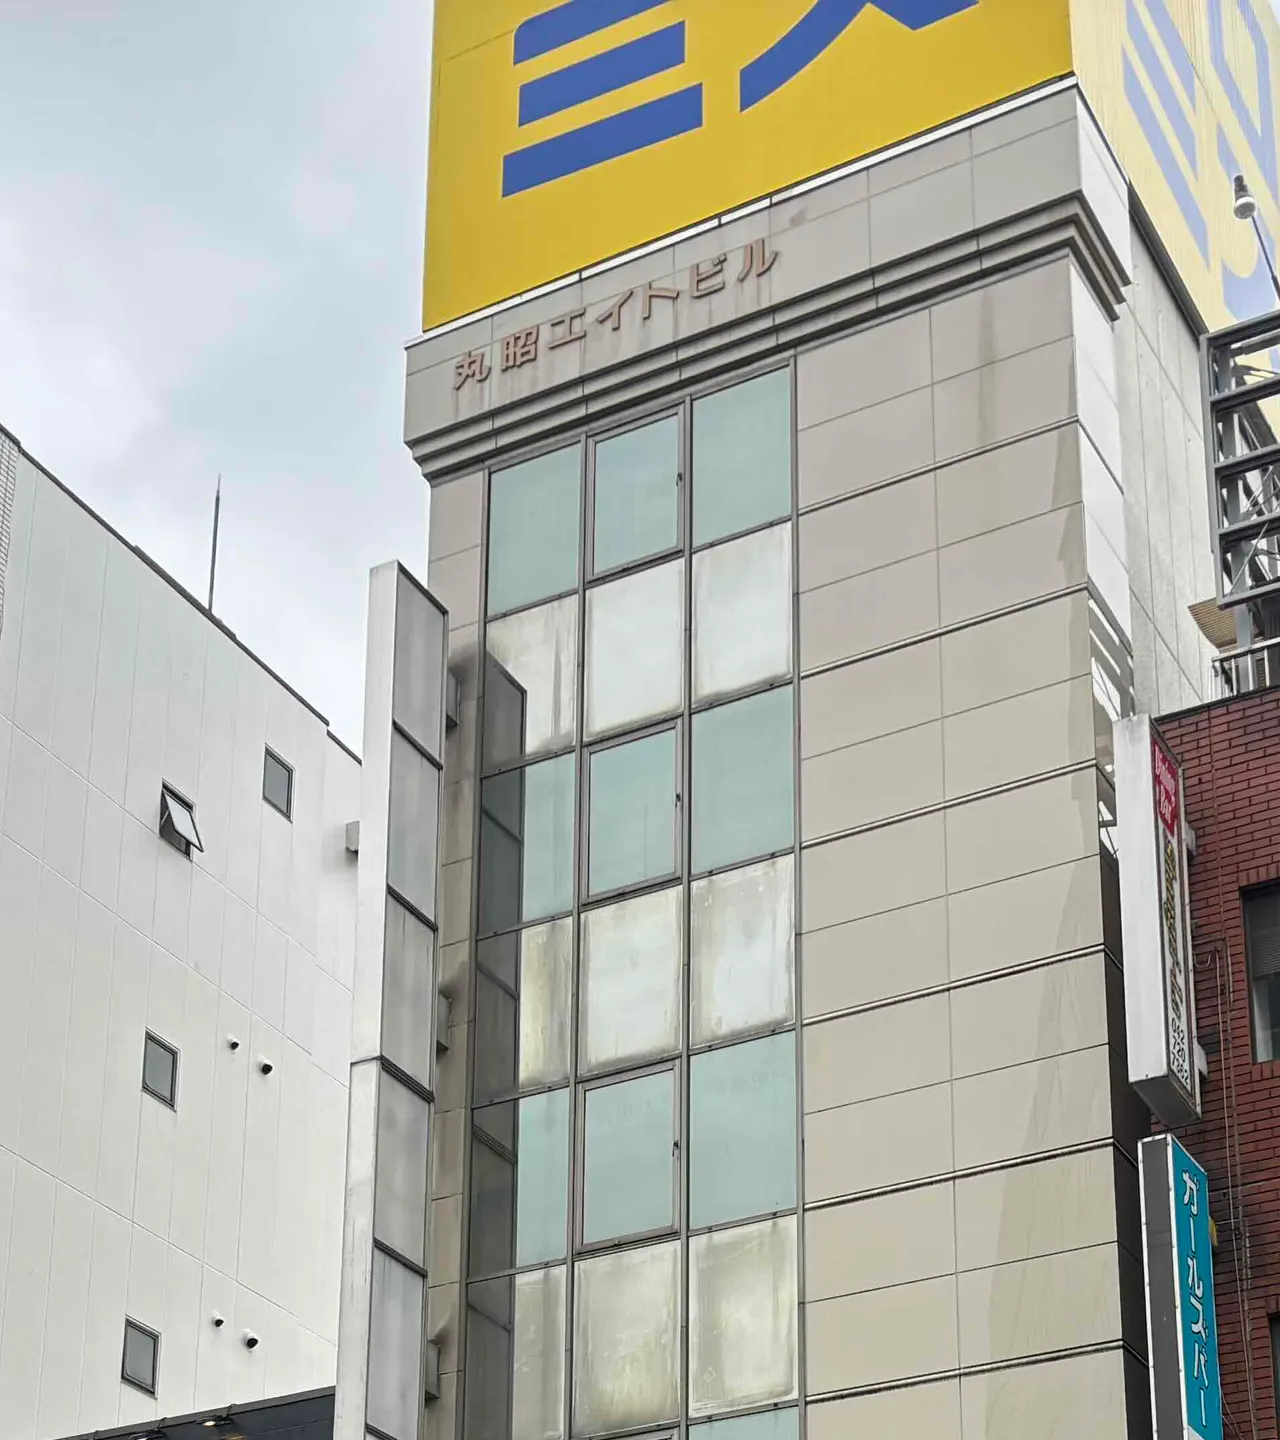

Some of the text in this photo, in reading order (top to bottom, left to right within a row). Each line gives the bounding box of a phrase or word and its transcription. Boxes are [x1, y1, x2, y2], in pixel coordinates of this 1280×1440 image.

[451, 236, 780, 391] 丸昭エイトビル
[1181, 1169, 1209, 1428] ガールズバー
